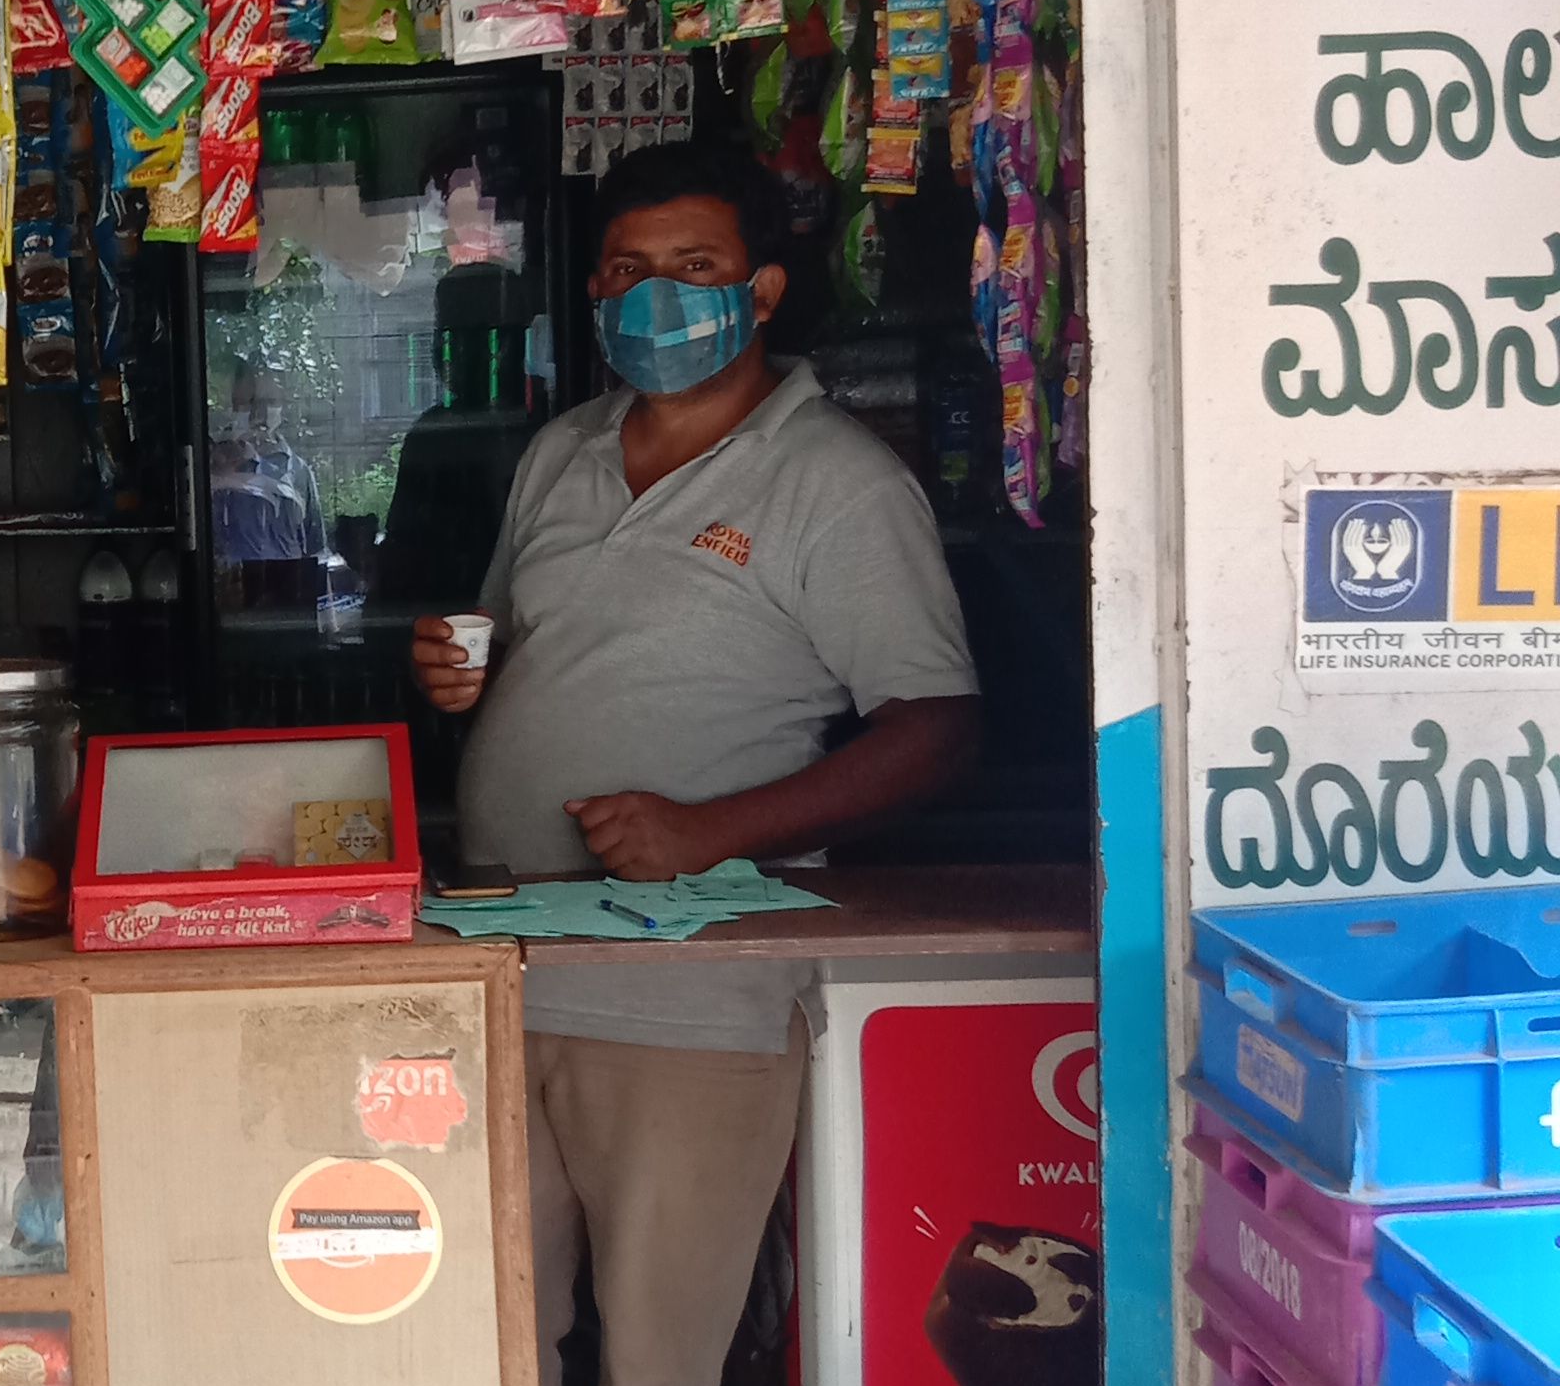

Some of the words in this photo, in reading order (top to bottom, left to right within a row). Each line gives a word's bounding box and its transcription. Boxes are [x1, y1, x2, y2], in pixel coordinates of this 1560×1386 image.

[704, 520, 751, 550] ROYAL
[690, 533, 750, 567] ENFIELD
[1301, 627, 1405, 651] भारतीय
[1422, 626, 1505, 650] जीवन
[1300, 655, 1337, 669] LIFE
[1343, 654, 1451, 669] INSURANCE
[299, 1212, 317, 1227] Pay
[320, 1214, 347, 1227] using
[349, 1213, 390, 1225] Amazon
[393, 1214, 413, 1228] app
[1237, 1220, 1302, 1322] 08/2018
